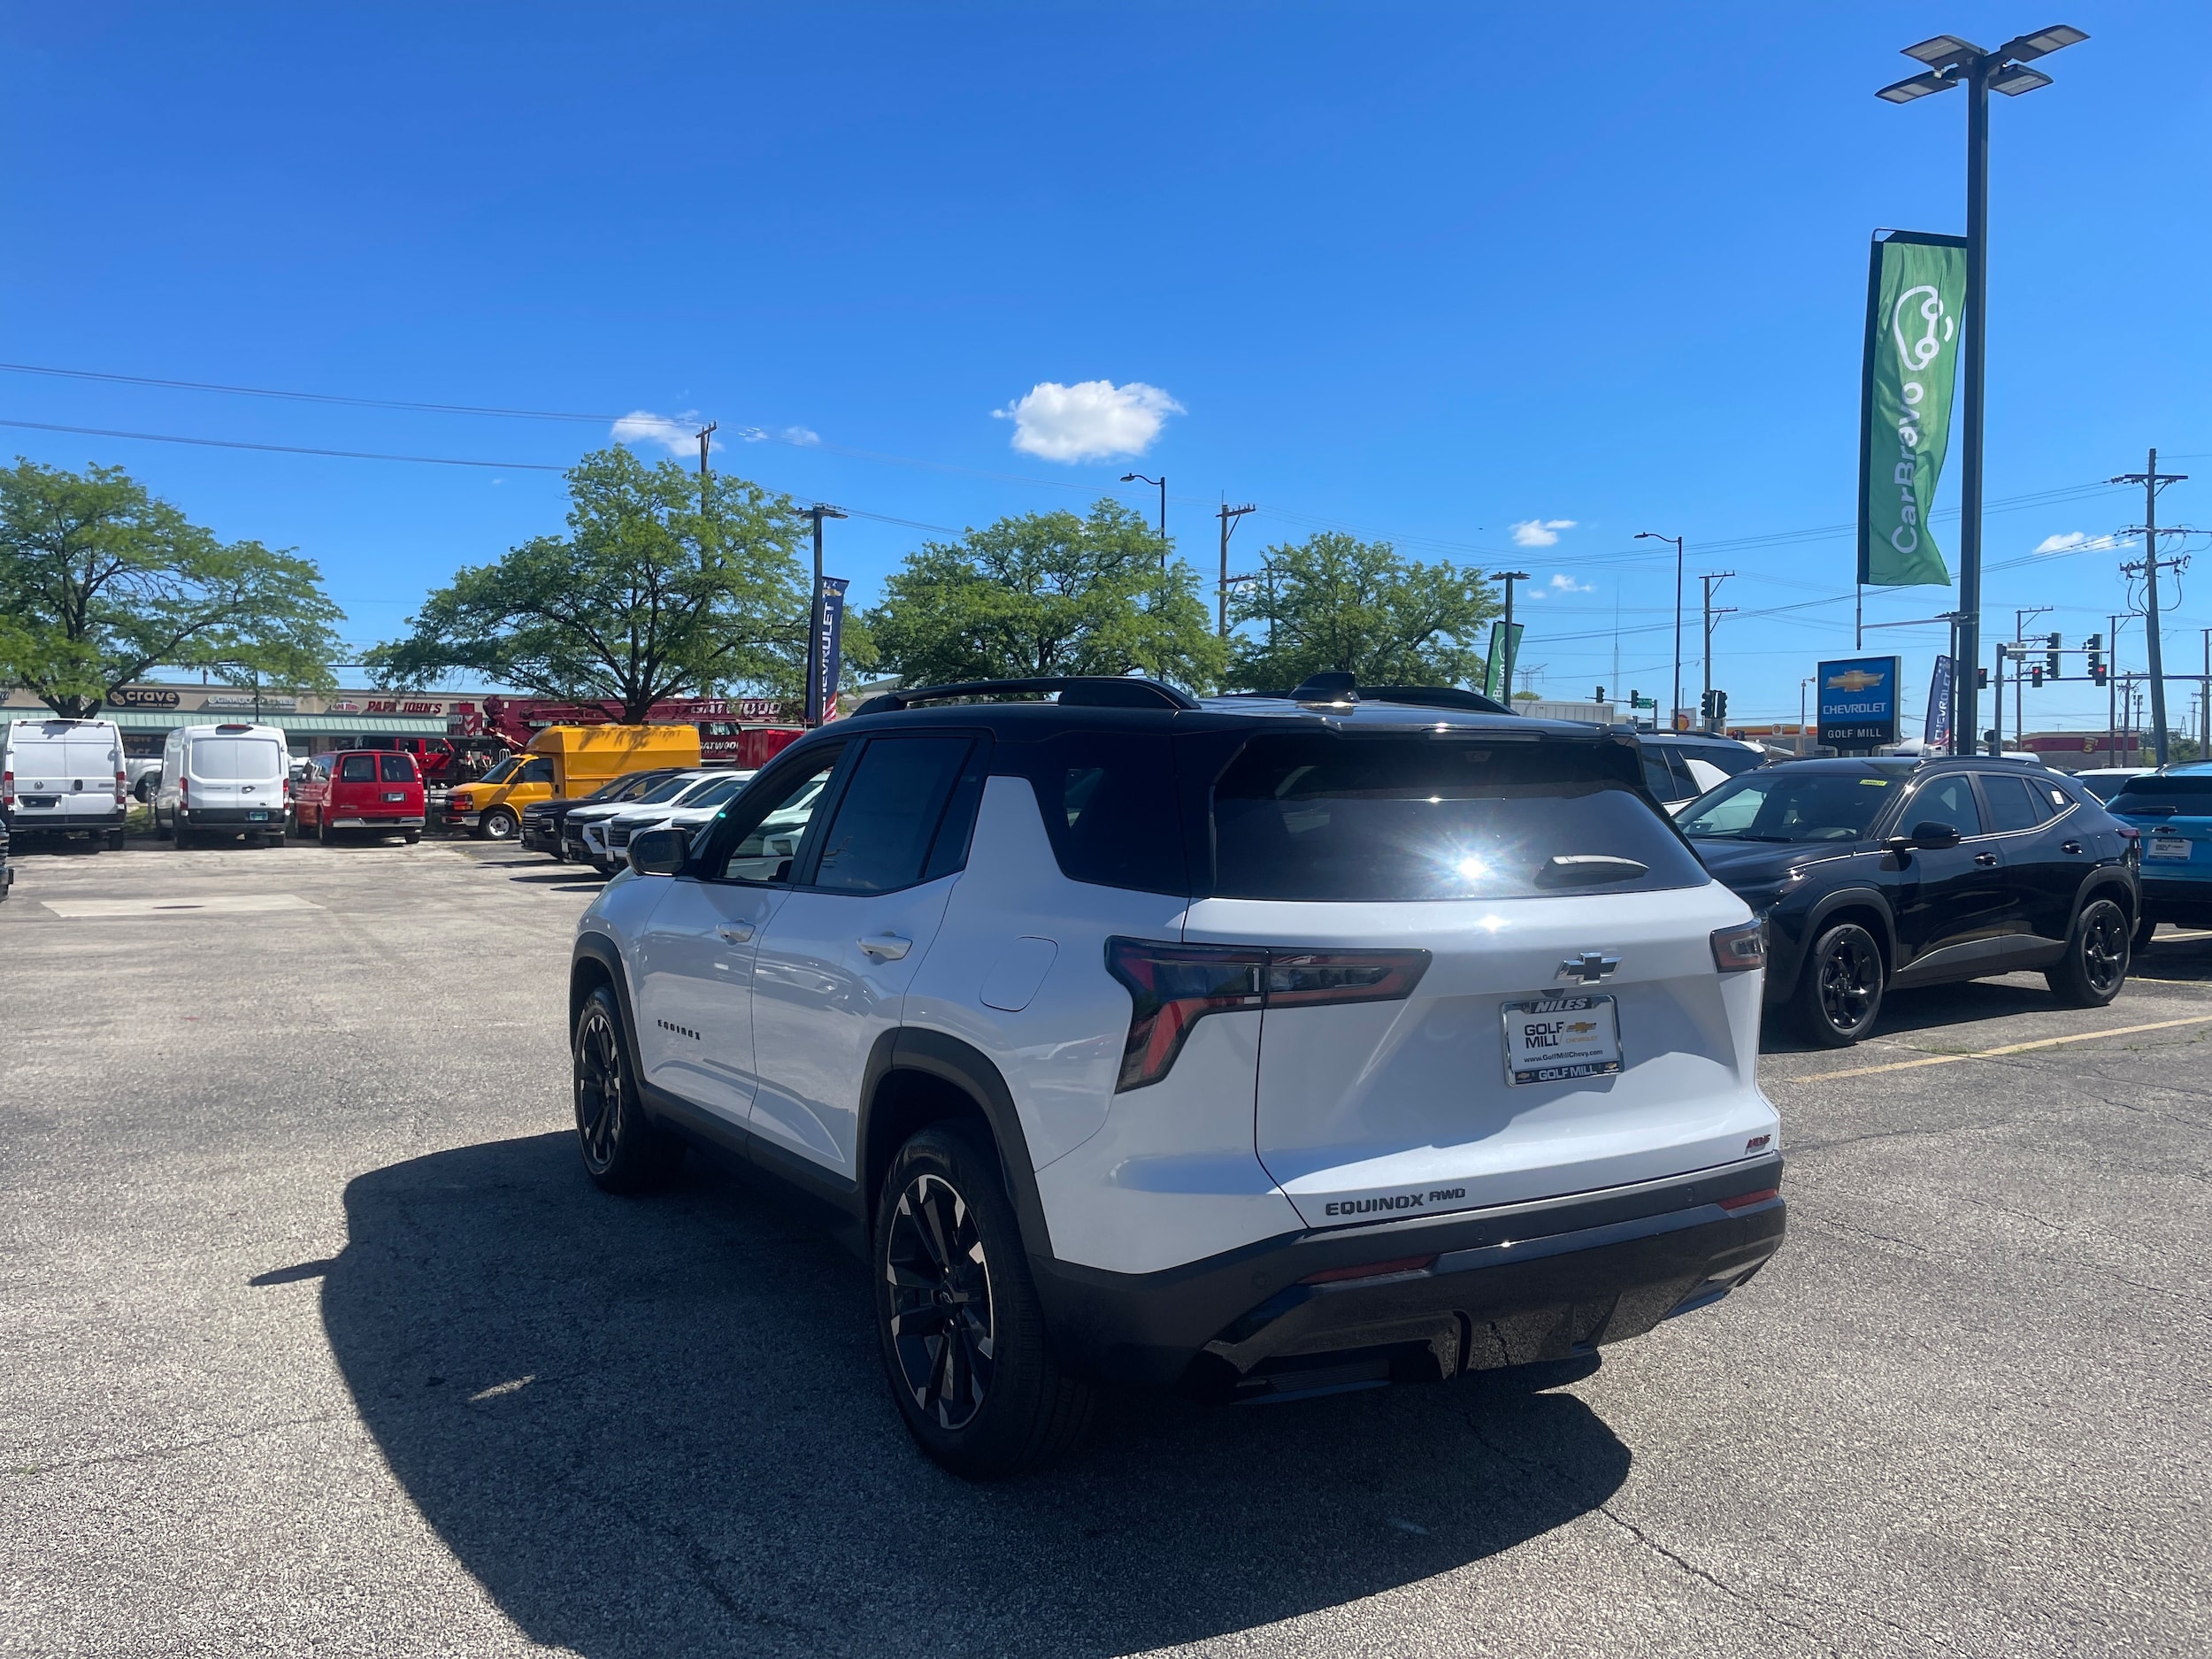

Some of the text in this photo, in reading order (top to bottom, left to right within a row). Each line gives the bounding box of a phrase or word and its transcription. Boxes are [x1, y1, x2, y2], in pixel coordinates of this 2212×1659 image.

[1890, 381, 1924, 555] CarBravo
[127, 691, 175, 702] crave
[366, 701, 442, 714] PAPA JOHN'S
[690, 701, 782, 715] GATOOD
[1823, 703, 1886, 714] CHEVROLET
[1934, 672, 1951, 741] CHEVROLET
[1828, 728, 1882, 738] GOLF MILL
[1534, 998, 1587, 1013] NILES
[657, 1019, 700, 1041] EQUINOX
[1525, 1021, 1564, 1035] GOLF
[1525, 1034, 1559, 1048] MILL
[1524, 1049, 1603, 1063] www.GolfMillChevy.com
[1539, 1069, 1569, 1080] GOLF
[1571, 1064, 1597, 1078] MILL
[1325, 1187, 1466, 1216] EQUINOX AWD
